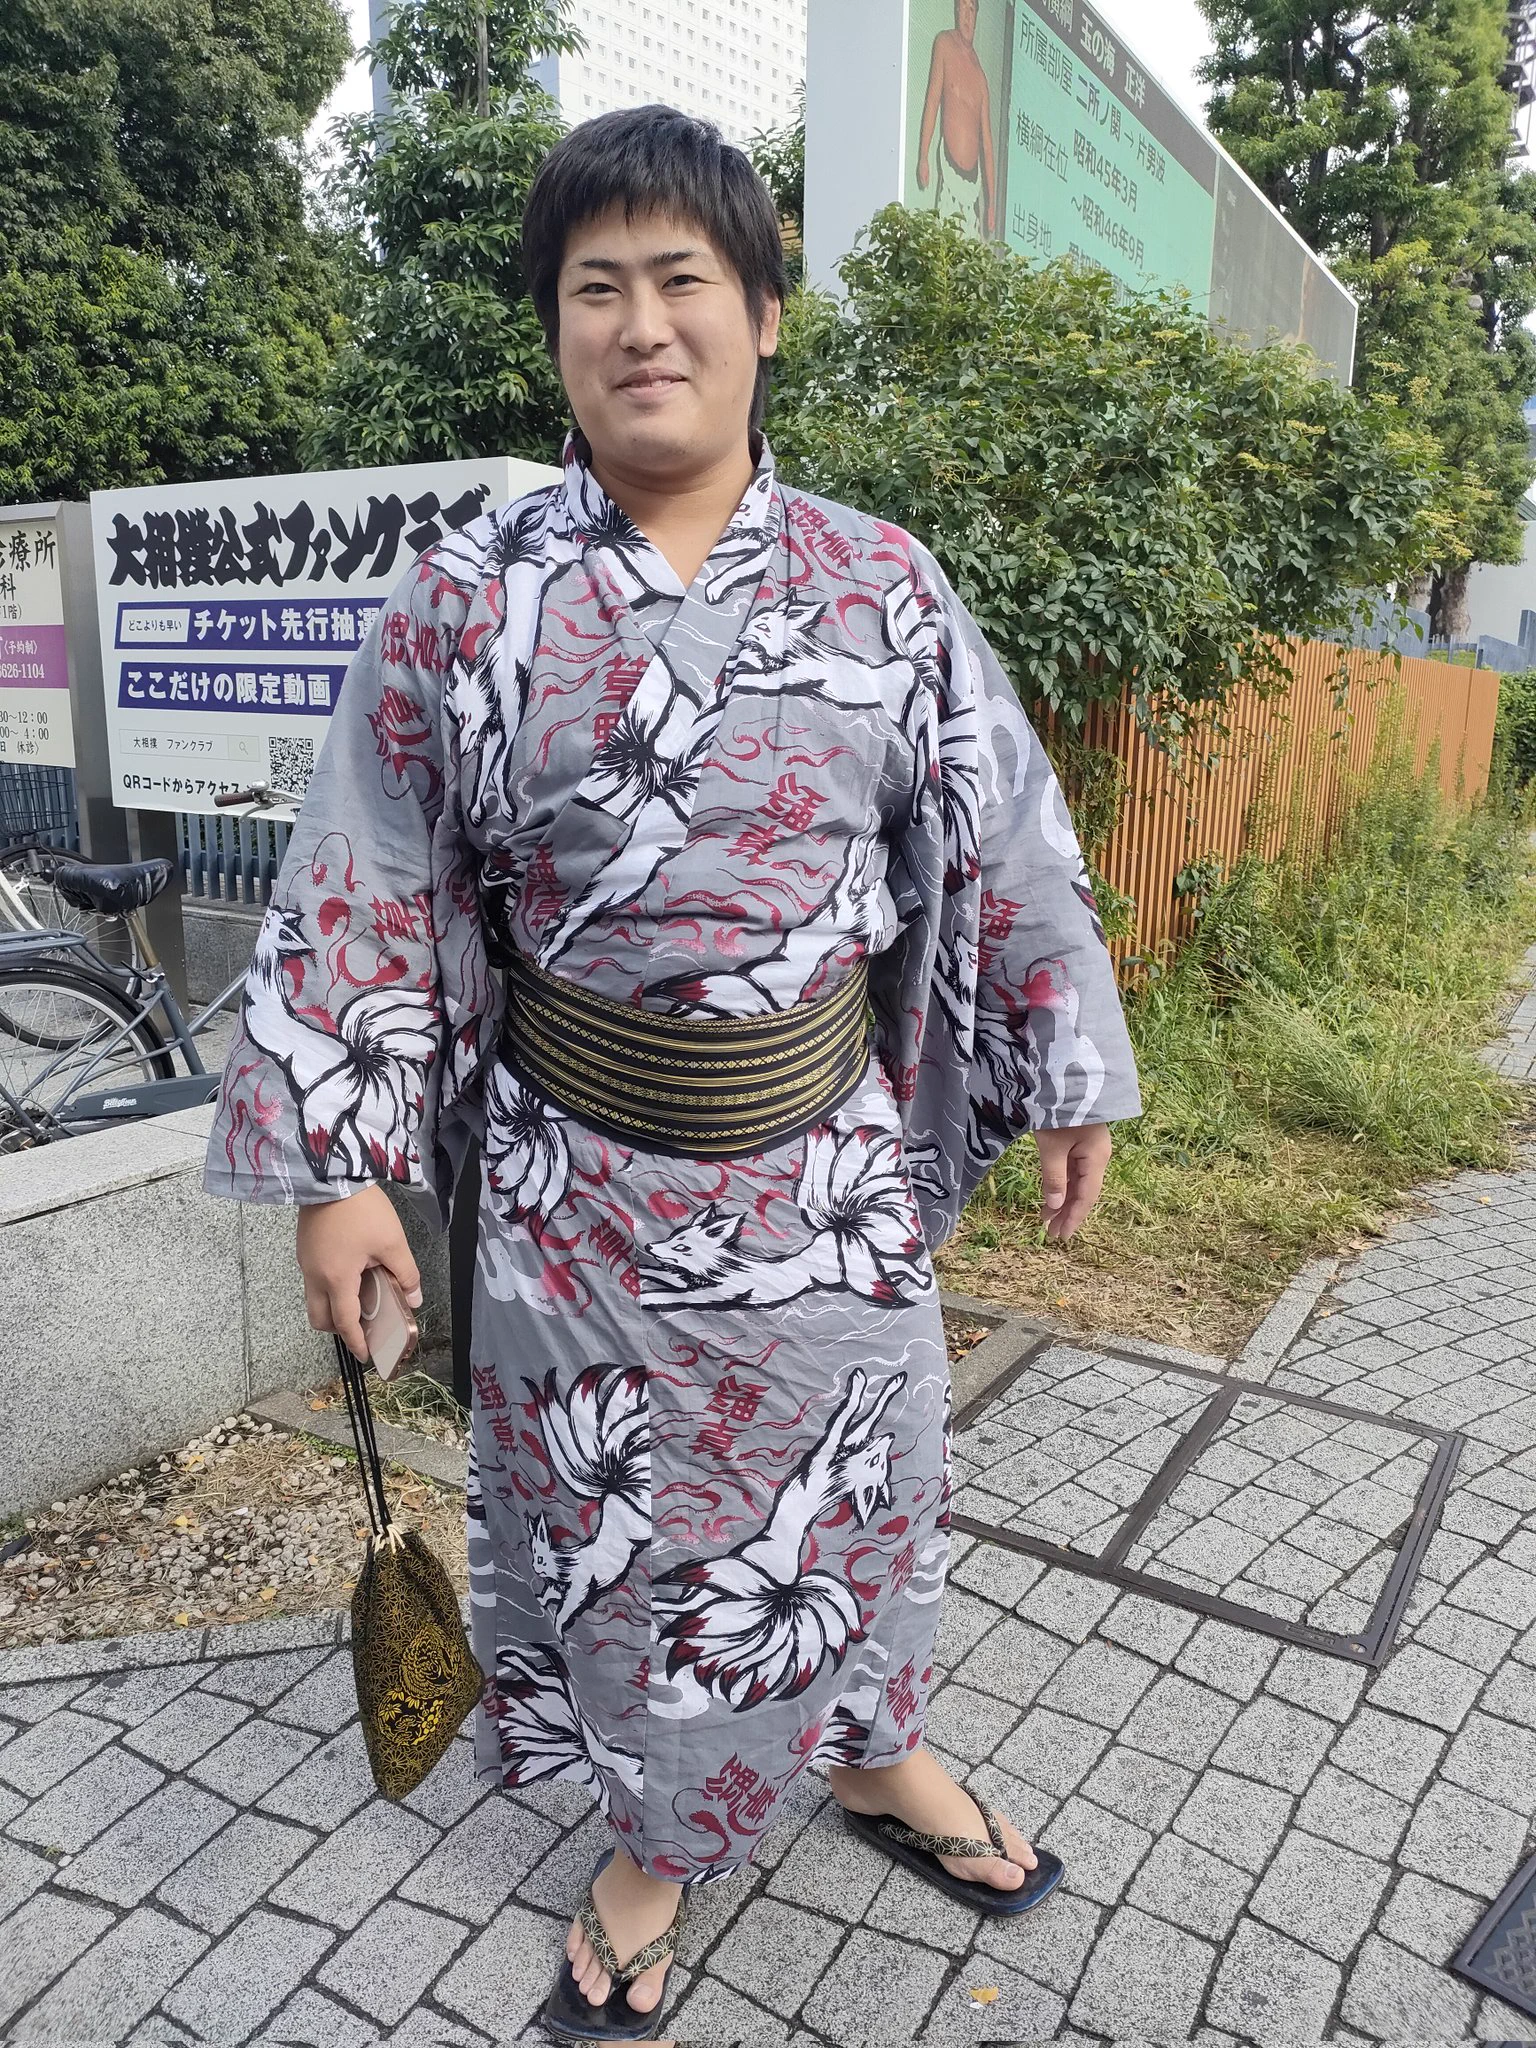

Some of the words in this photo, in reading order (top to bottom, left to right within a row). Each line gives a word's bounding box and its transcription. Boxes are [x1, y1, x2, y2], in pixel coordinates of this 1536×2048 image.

[1020, 13, 1073, 96] 所属部屋
[1080, 13, 1116, 77] 玉の海
[1124, 61, 1146, 109] 正洋
[1016, 108, 1069, 183] 横綱在位
[1073, 128, 1138, 212] 昭和45年3月
[1012, 203, 1052, 258] 出身地
[128, 619, 182, 631] どこよりも早い
[127, 671, 331, 707] ここだけの限定動画
[133, 736, 158, 749] 大相撲
[167, 739, 213, 752] ファンクラブ
